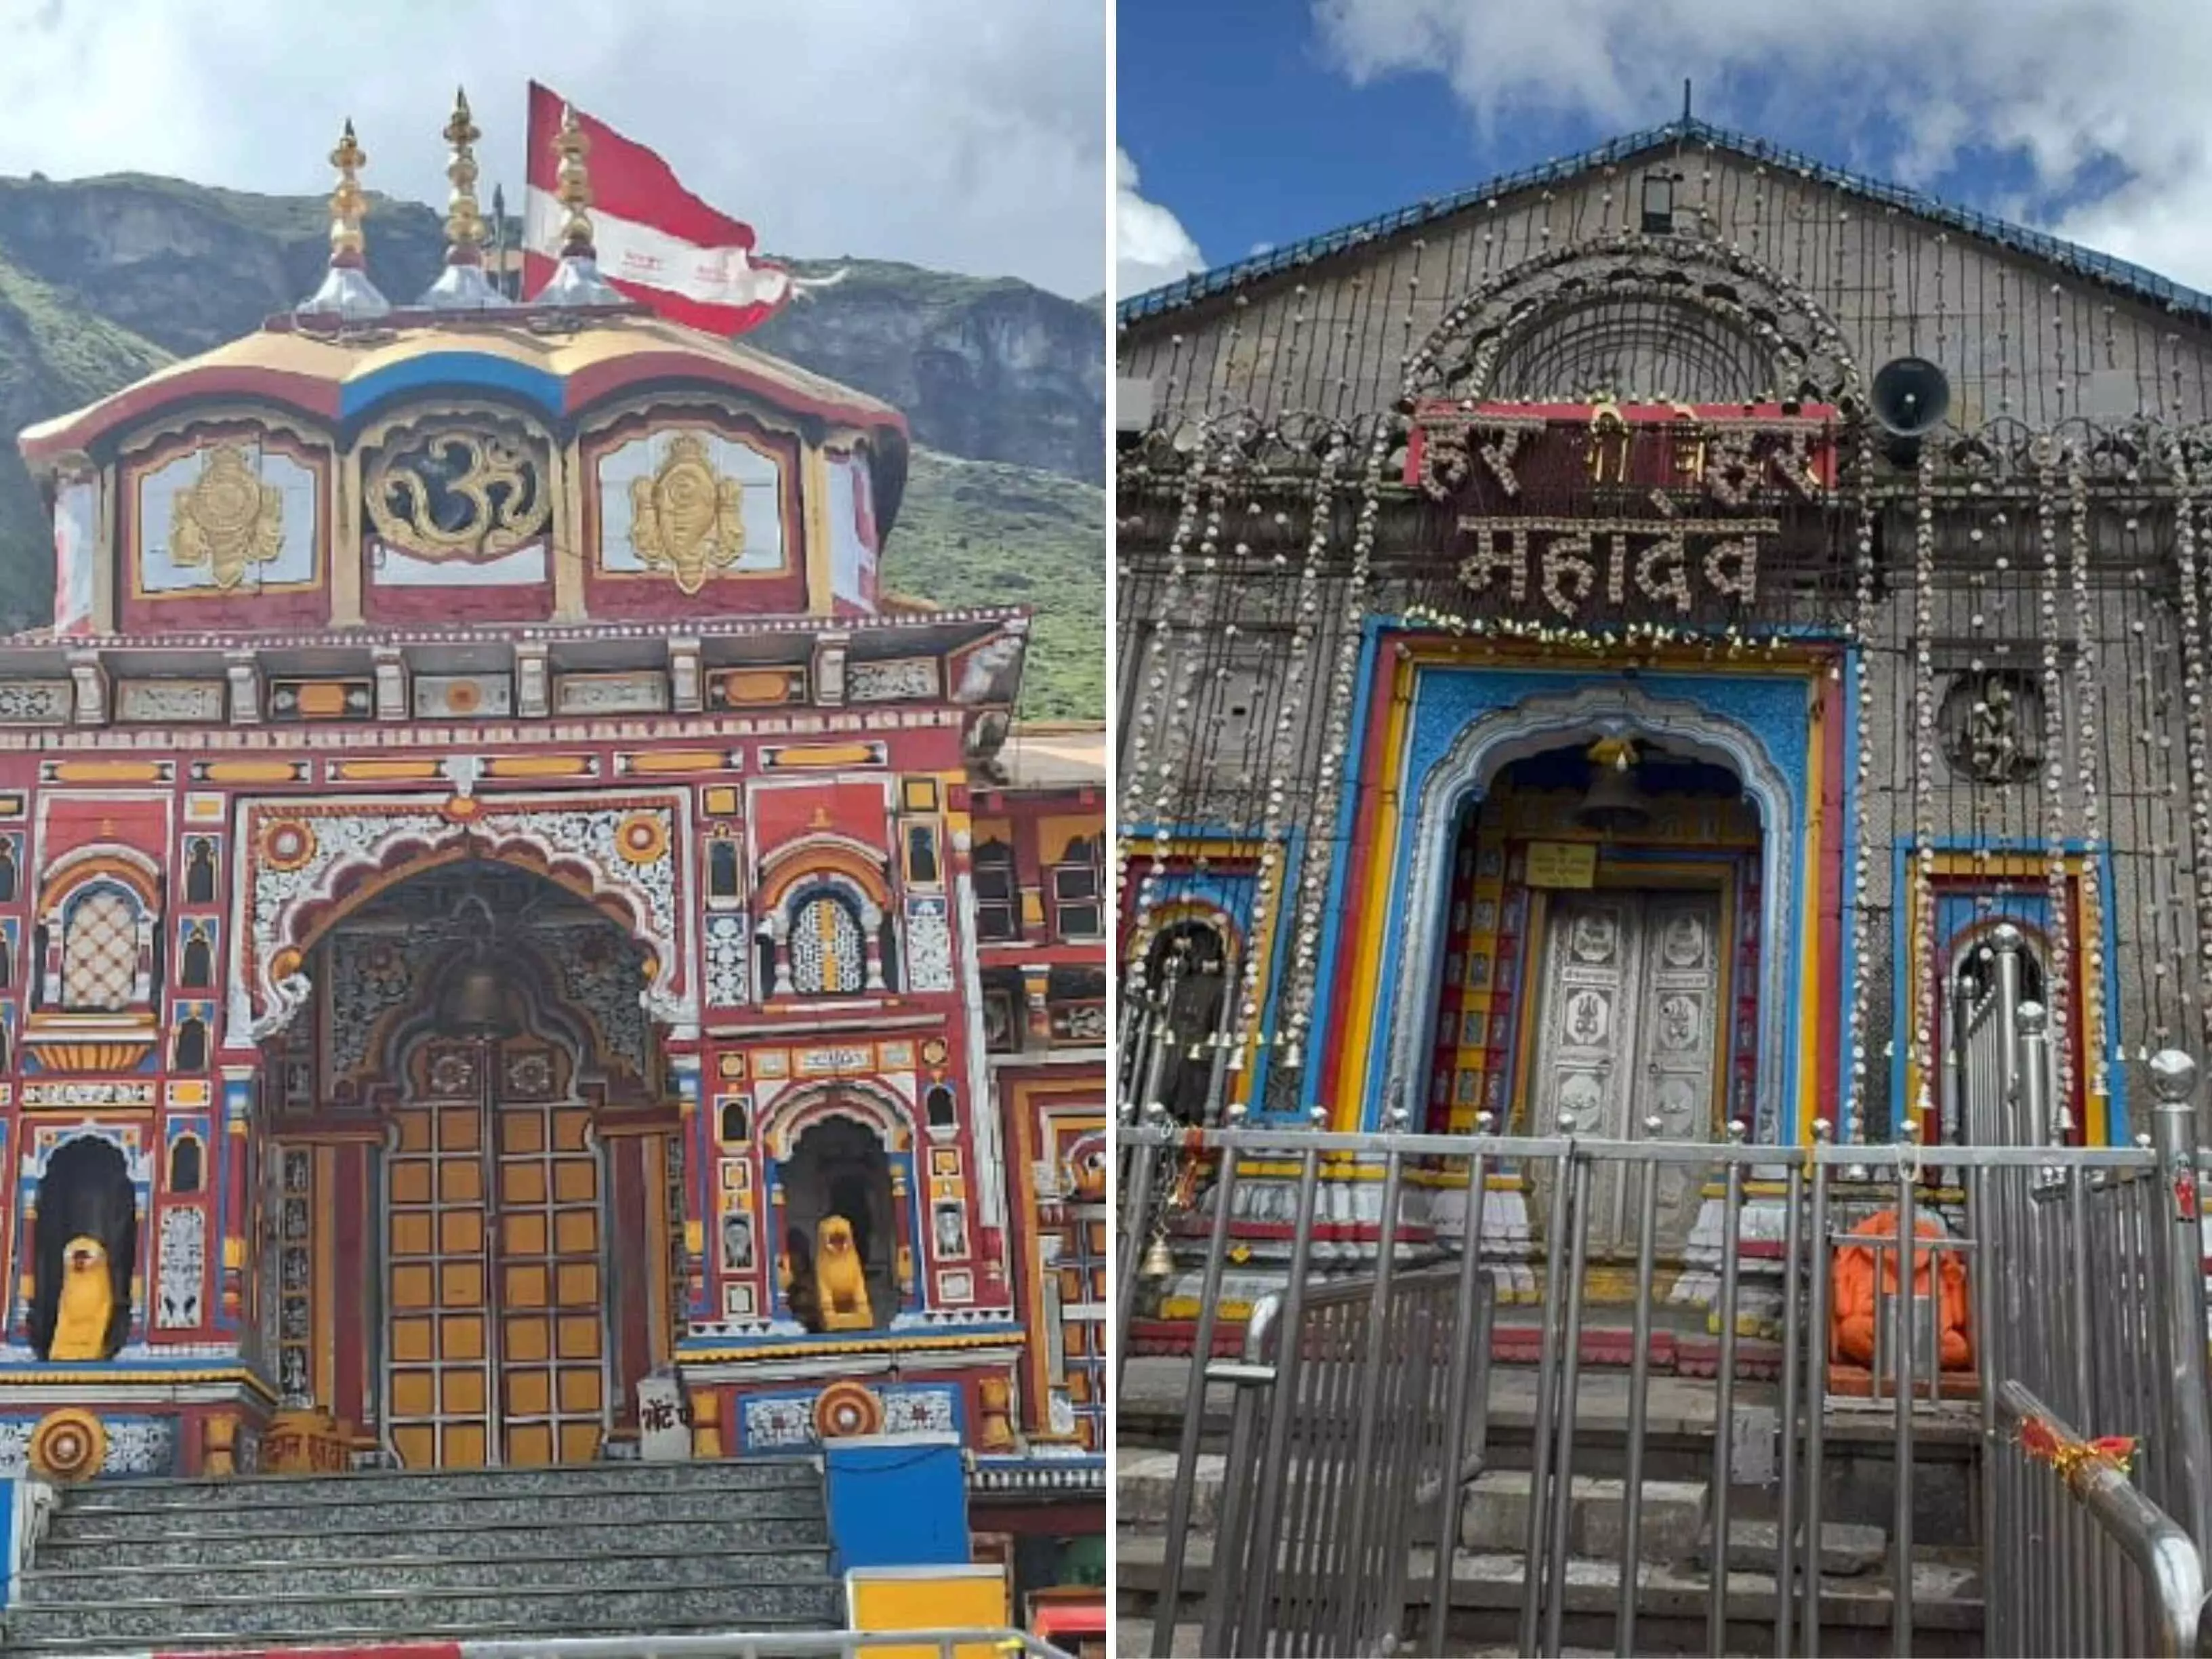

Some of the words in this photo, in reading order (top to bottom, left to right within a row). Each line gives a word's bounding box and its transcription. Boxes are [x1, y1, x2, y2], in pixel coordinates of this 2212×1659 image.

[1418, 415, 1546, 501] हर
[1700, 416, 1823, 504] हर
[1457, 488, 1780, 617] महादेव
